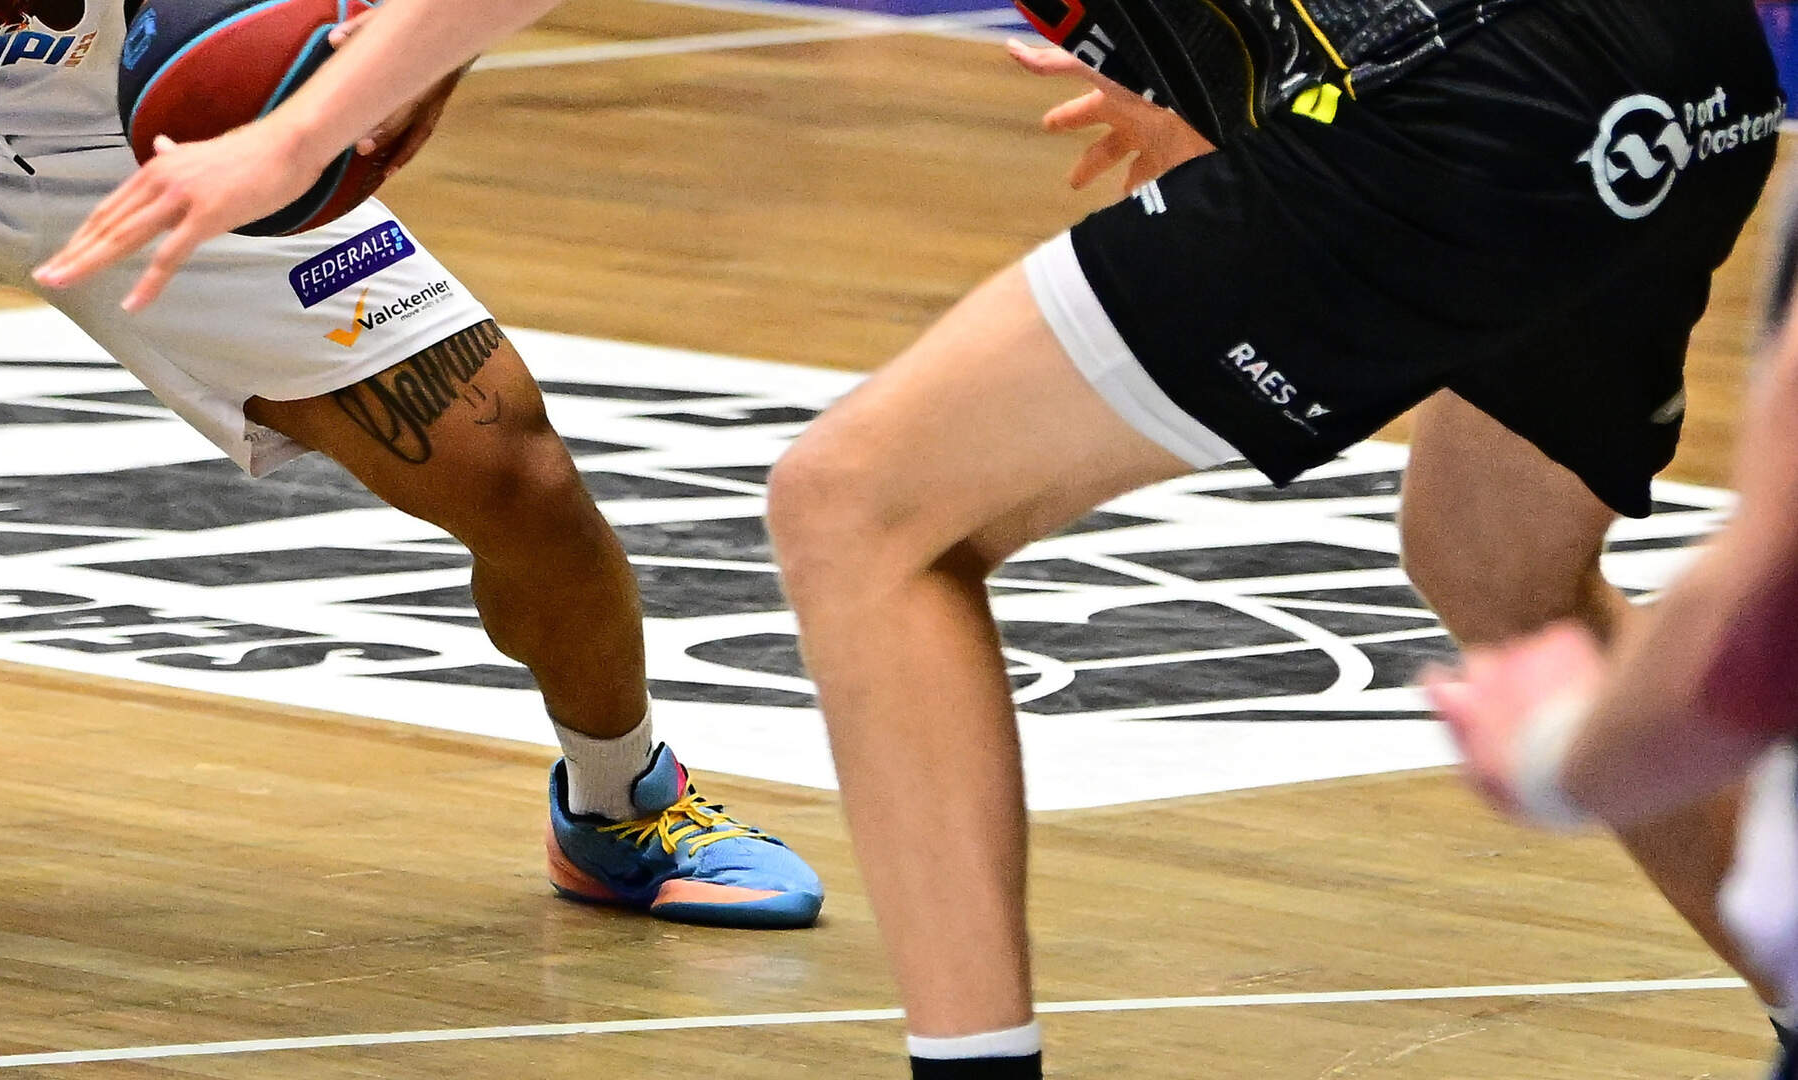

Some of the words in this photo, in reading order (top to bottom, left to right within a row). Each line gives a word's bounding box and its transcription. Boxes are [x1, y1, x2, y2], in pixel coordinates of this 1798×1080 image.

[1698, 95, 1787, 160] Oostend
[300, 230, 392, 291] FEDERALE
[356, 279, 451, 331] Valckenier
[1227, 342, 1298, 405] RAES
